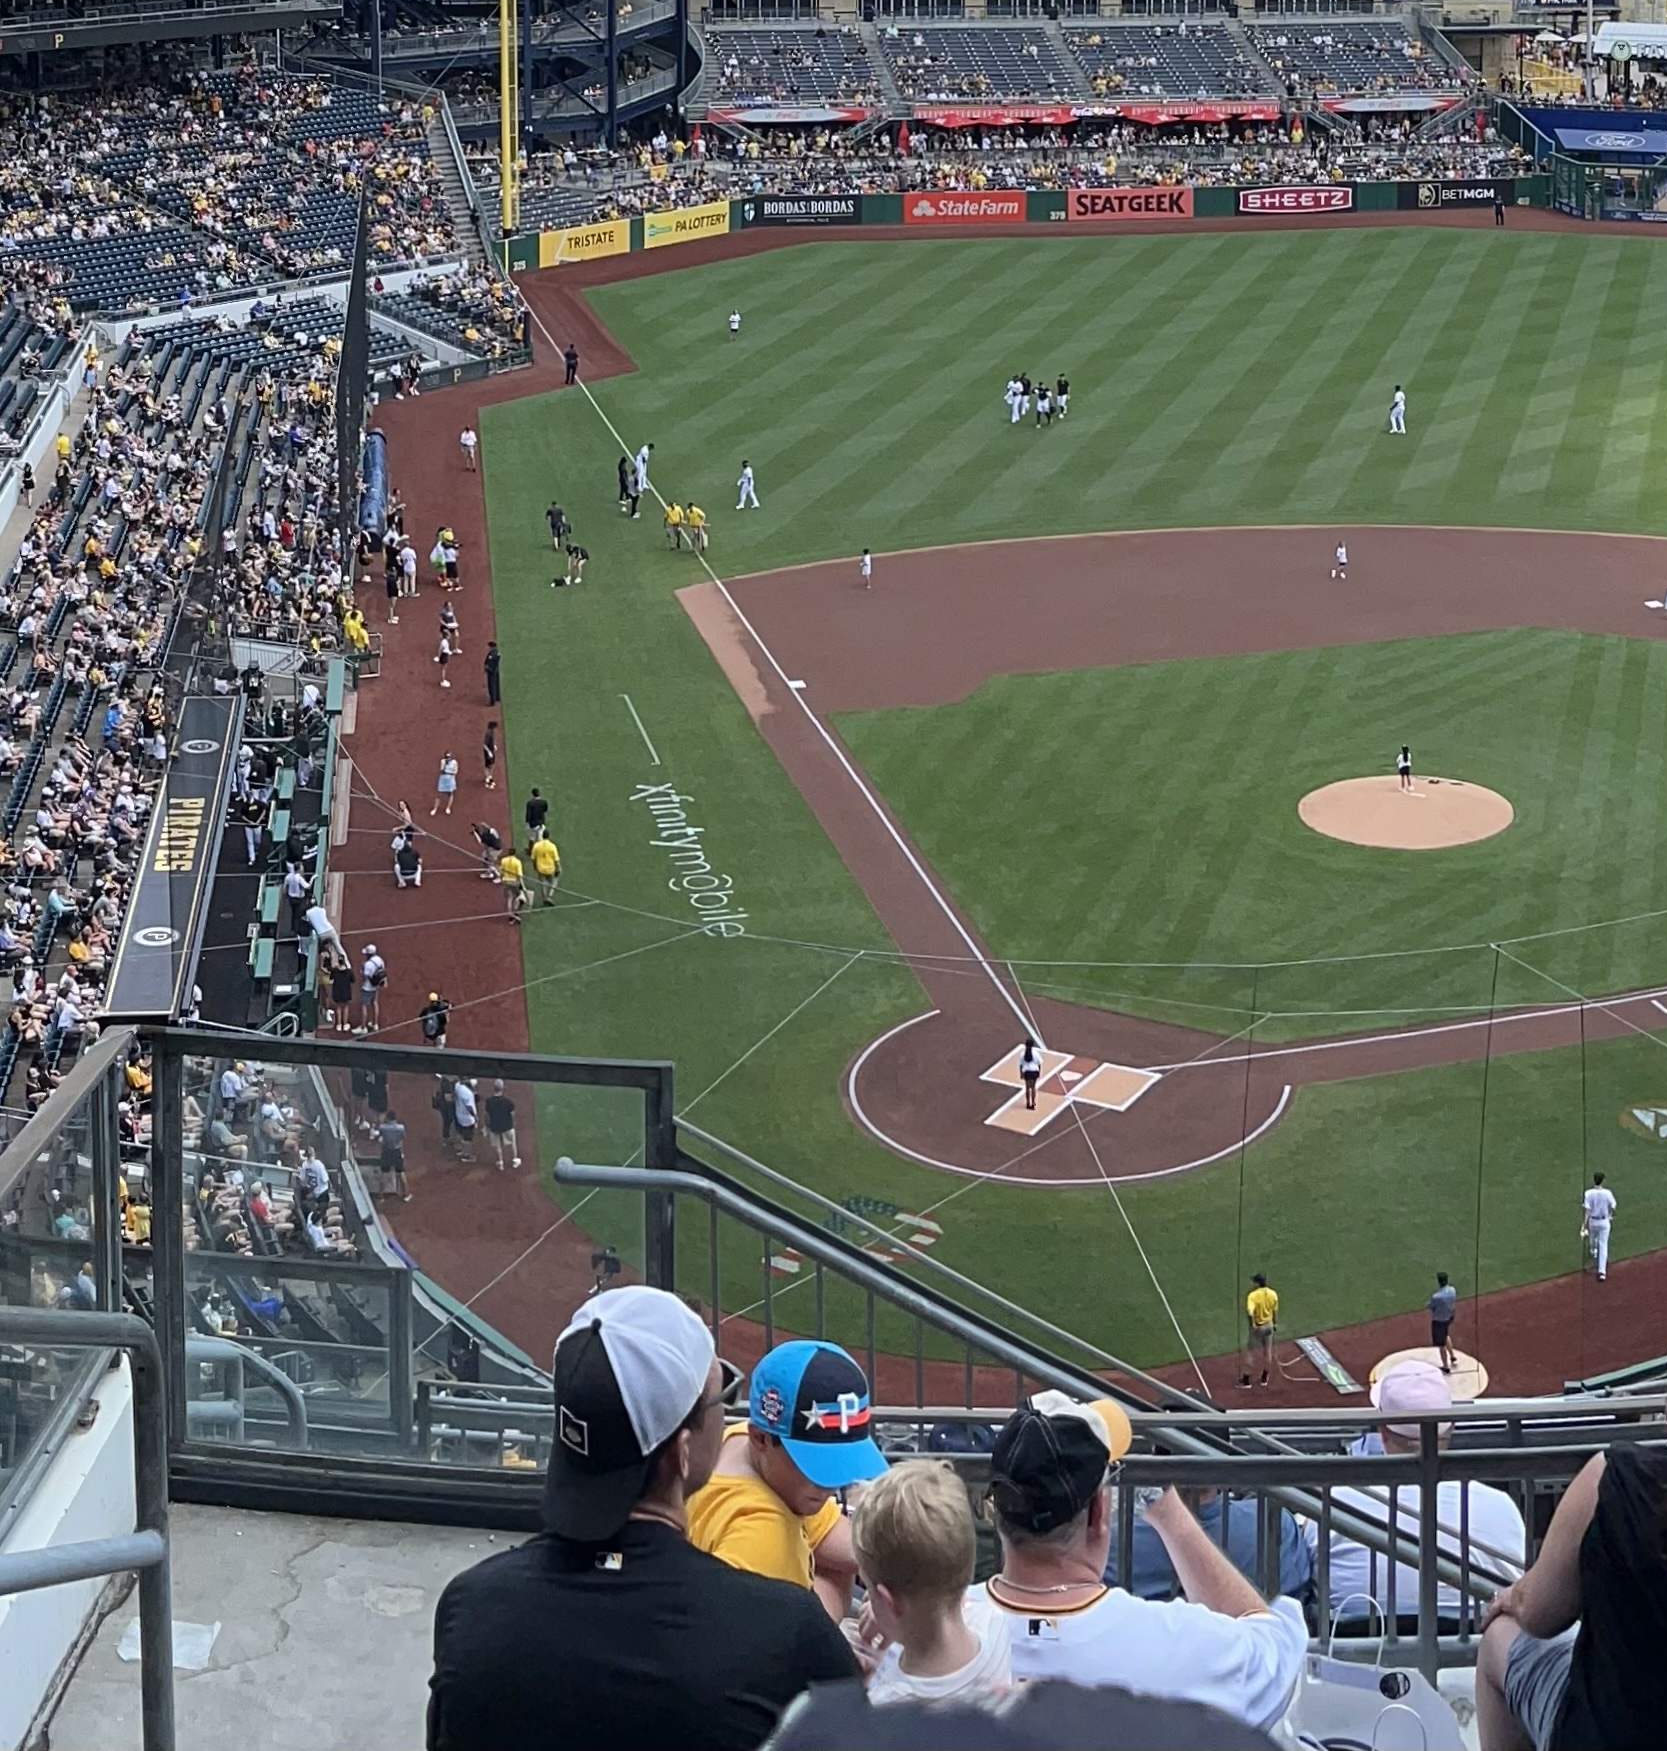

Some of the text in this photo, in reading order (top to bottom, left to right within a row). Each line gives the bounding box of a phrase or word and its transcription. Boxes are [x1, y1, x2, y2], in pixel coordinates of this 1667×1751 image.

[1595, 134, 1635, 148] Ford
[1076, 191, 1185, 215] SEATGEEK
[1247, 191, 1344, 208] SHEETZ
[1442, 188, 1495, 200] BETMGM
[764, 200, 854, 215] BORDAS BORDAS
[674, 219, 689, 233] PA
[689, 212, 728, 230] LOTTERY
[567, 230, 615, 250] TRISTATE
[153, 797, 206, 872] PIRATES
[837, 1392, 859, 1434] P
